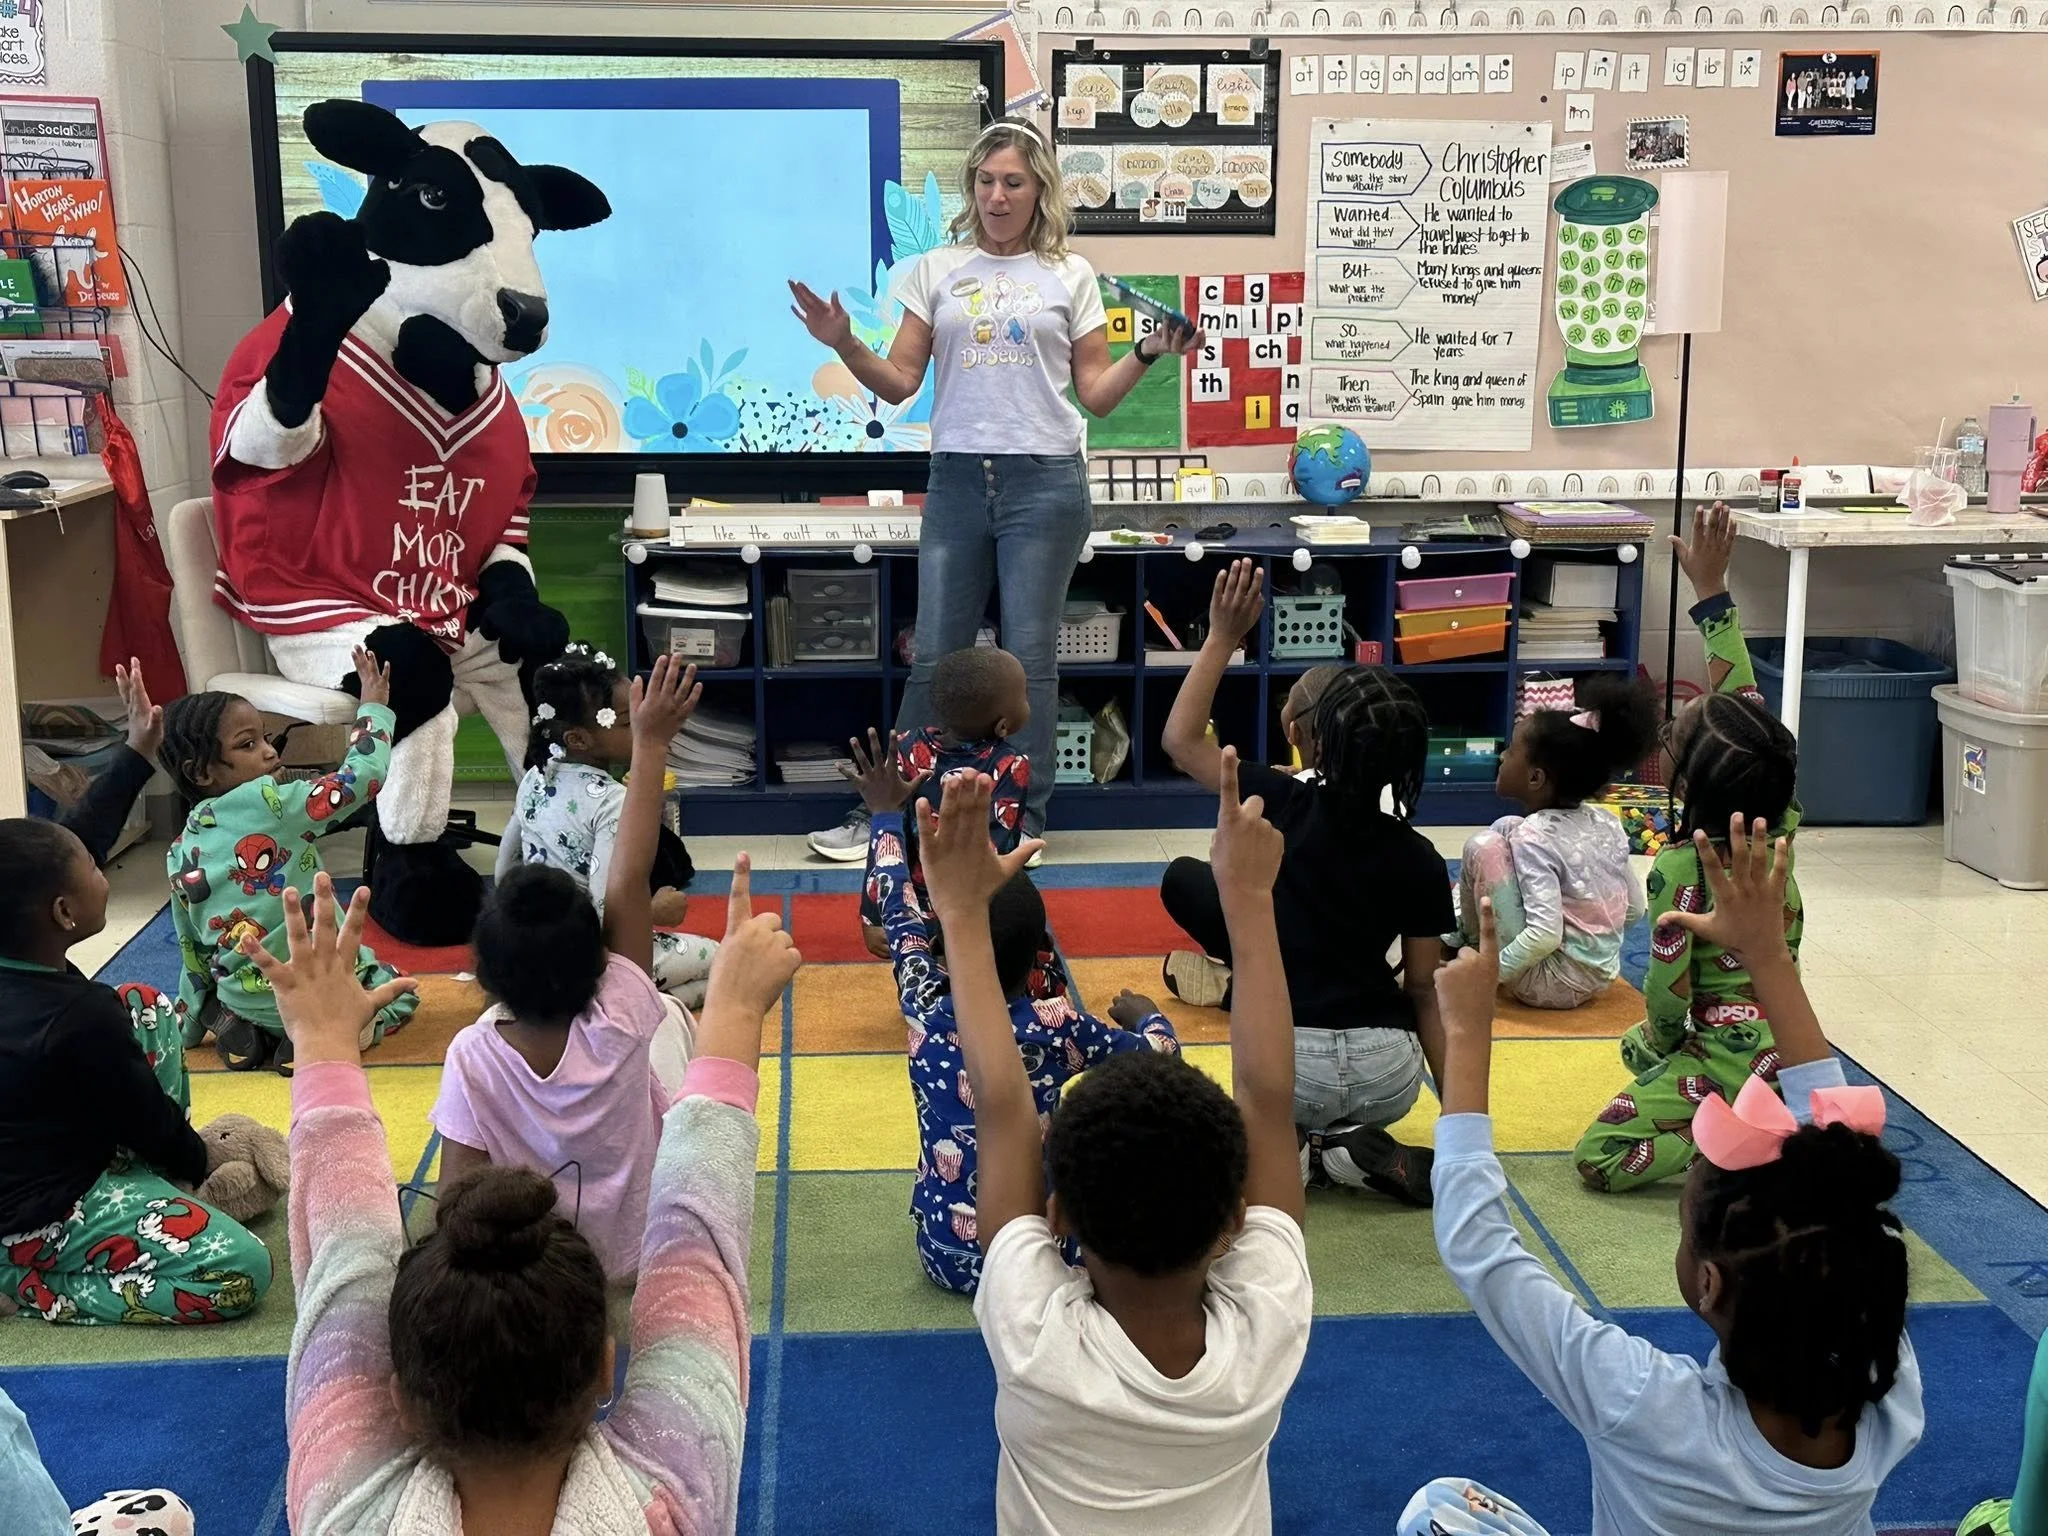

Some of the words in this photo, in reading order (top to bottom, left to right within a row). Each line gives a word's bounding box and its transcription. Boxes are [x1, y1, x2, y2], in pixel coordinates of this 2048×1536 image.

[0, 39, 24, 51] art
[1296, 64, 1313, 82] at
[1393, 70, 1413, 81] an
[1424, 63, 1445, 81] ad
[1452, 70, 1479, 81] am
[1489, 63, 1509, 80] ab
[1562, 63, 1575, 85] ip
[1593, 62, 1607, 77] in
[1629, 62, 1640, 80] it
[1672, 58, 1686, 81] ig
[1704, 58, 1717, 75] ib
[1740, 63, 1751, 75] ix
[1328, 70, 1347, 88] ap
[1360, 70, 1380, 89] ag
[1442, 142, 1547, 180] Christopher
[14, 185, 63, 214] HORTON
[1440, 176, 1525, 205] Columbus
[41, 194, 76, 222] HEARS
[70, 191, 103, 221] WHO!
[1425, 203, 1440, 222] He
[1447, 205, 1495, 222] wanted
[1498, 205, 1512, 221] to
[1357, 227, 1370, 237] did
[1373, 227, 1394, 237] they
[1417, 224, 1453, 242] travel
[1456, 227, 1484, 243] west
[1488, 226, 1498, 241] to
[1499, 228, 1517, 247] get
[1519, 227, 1529, 242] to
[1628, 229, 1643, 241] cr
[1418, 240, 1438, 254] the
[1417, 260, 1447, 279] Many
[1484, 263, 1504, 276] and
[1508, 265, 1543, 279] queens
[1562, 251, 1574, 270] pl
[1205, 285, 1217, 299] c
[1250, 282, 1264, 302] g
[1419, 277, 1458, 289] refused
[1462, 276, 1472, 290] to
[1476, 279, 1496, 294] give
[1500, 278, 1521, 289] him
[1112, 317, 1126, 332] a
[1200, 312, 1221, 330] m
[1226, 313, 1238, 328] n
[1277, 312, 1291, 332] p
[1415, 327, 1430, 344] He
[1436, 330, 1477, 346] waited
[1481, 331, 1498, 345] for
[1503, 332, 1513, 345] 7
[986, 345, 1034, 367] Seuss
[1205, 345, 1215, 359] s
[1255, 340, 1281, 358] ch
[1200, 373, 1222, 392] th
[1410, 368, 1430, 385] The
[1463, 371, 1482, 386] and
[1485, 375, 1515, 389] queen
[1517, 373, 1527, 386] of
[1412, 389, 1444, 408] Spain
[1452, 395, 1473, 410] gave
[1477, 392, 1495, 406] him
[1255, 400, 1260, 419] i
[398, 464, 485, 531] EAT
[674, 525, 693, 542] I
[713, 525, 736, 540] like
[748, 524, 771, 540] the
[783, 524, 811, 542] quilt
[825, 529, 840, 540] on
[852, 524, 877, 540] that
[888, 523, 917, 540] bed.
[391, 522, 465, 577] MOR
